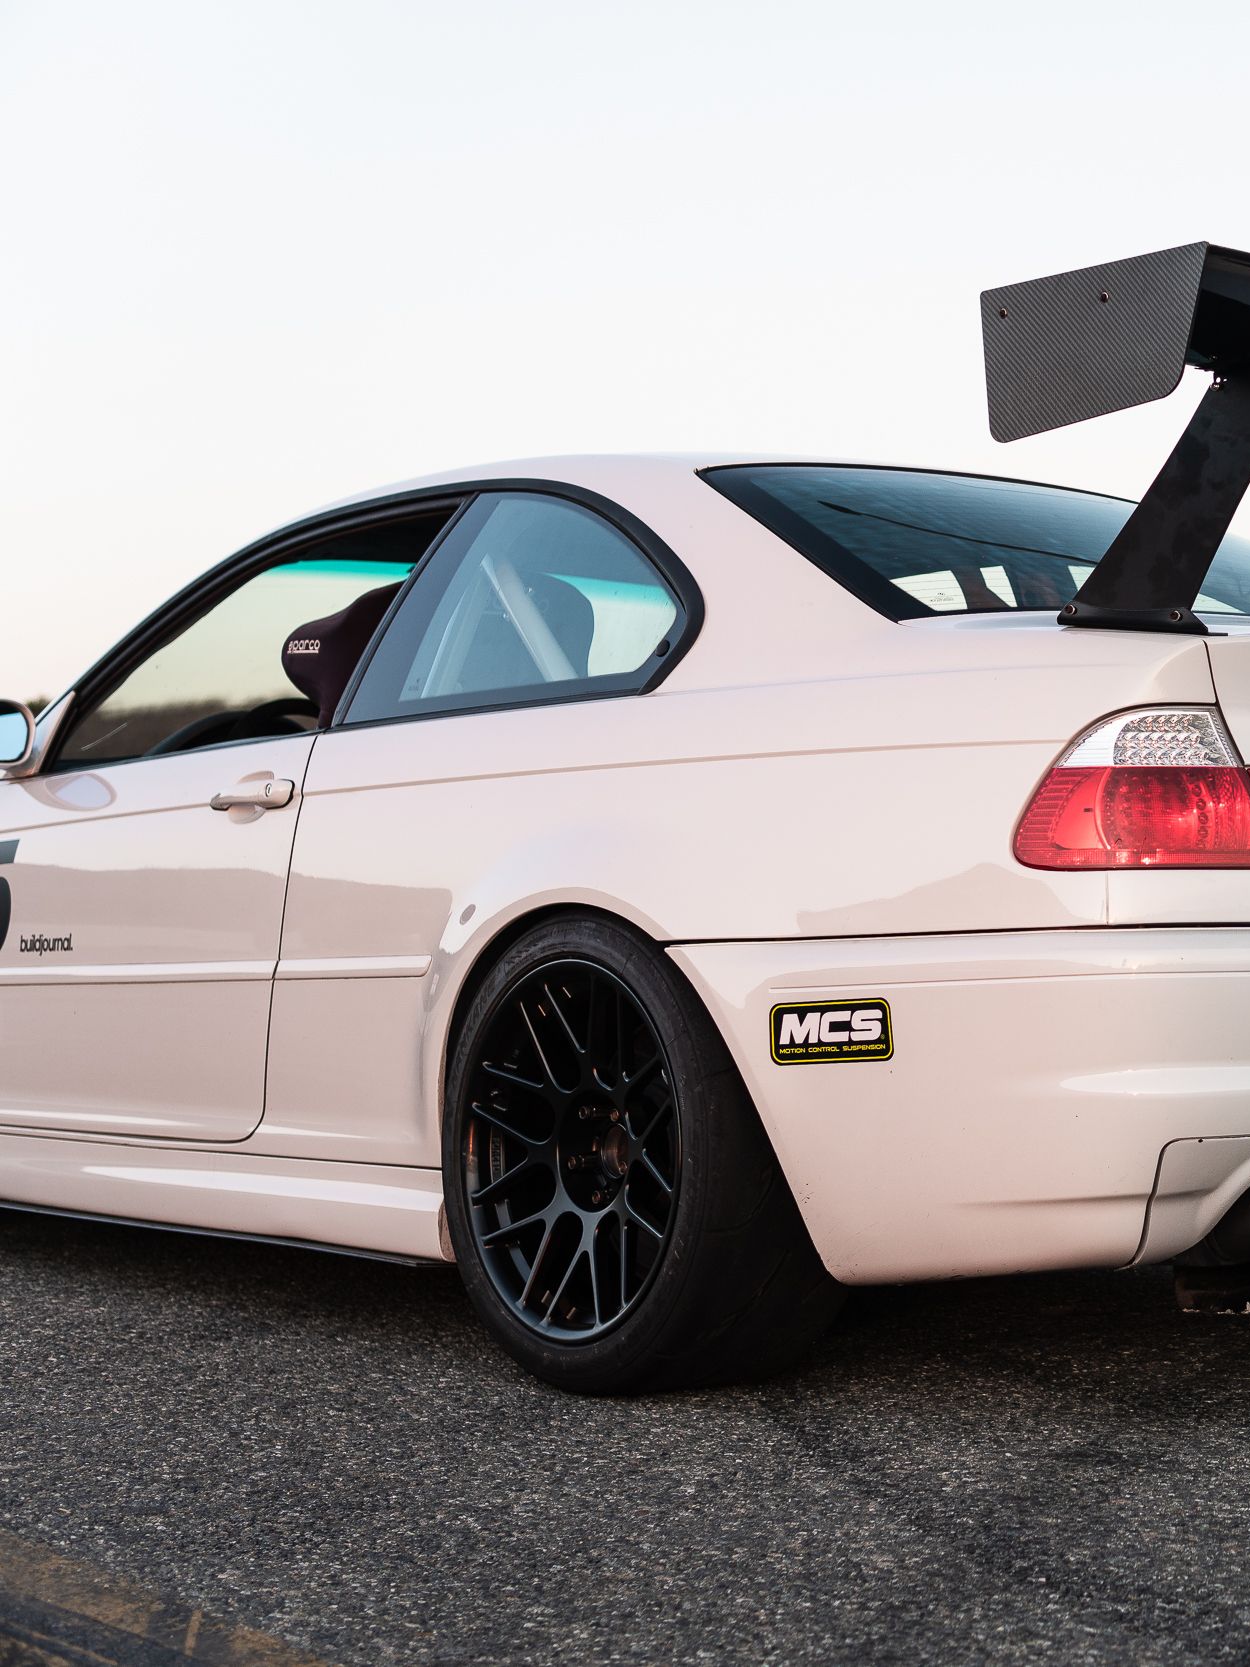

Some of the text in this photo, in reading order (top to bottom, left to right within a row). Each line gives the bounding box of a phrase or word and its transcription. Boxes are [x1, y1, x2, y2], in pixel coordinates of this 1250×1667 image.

[287, 639, 320, 654] sparco
[20, 932, 73, 957] buildjournal.
[779, 1009, 883, 1045] MCS
[842, 1043, 886, 1052] SUSPENSION
